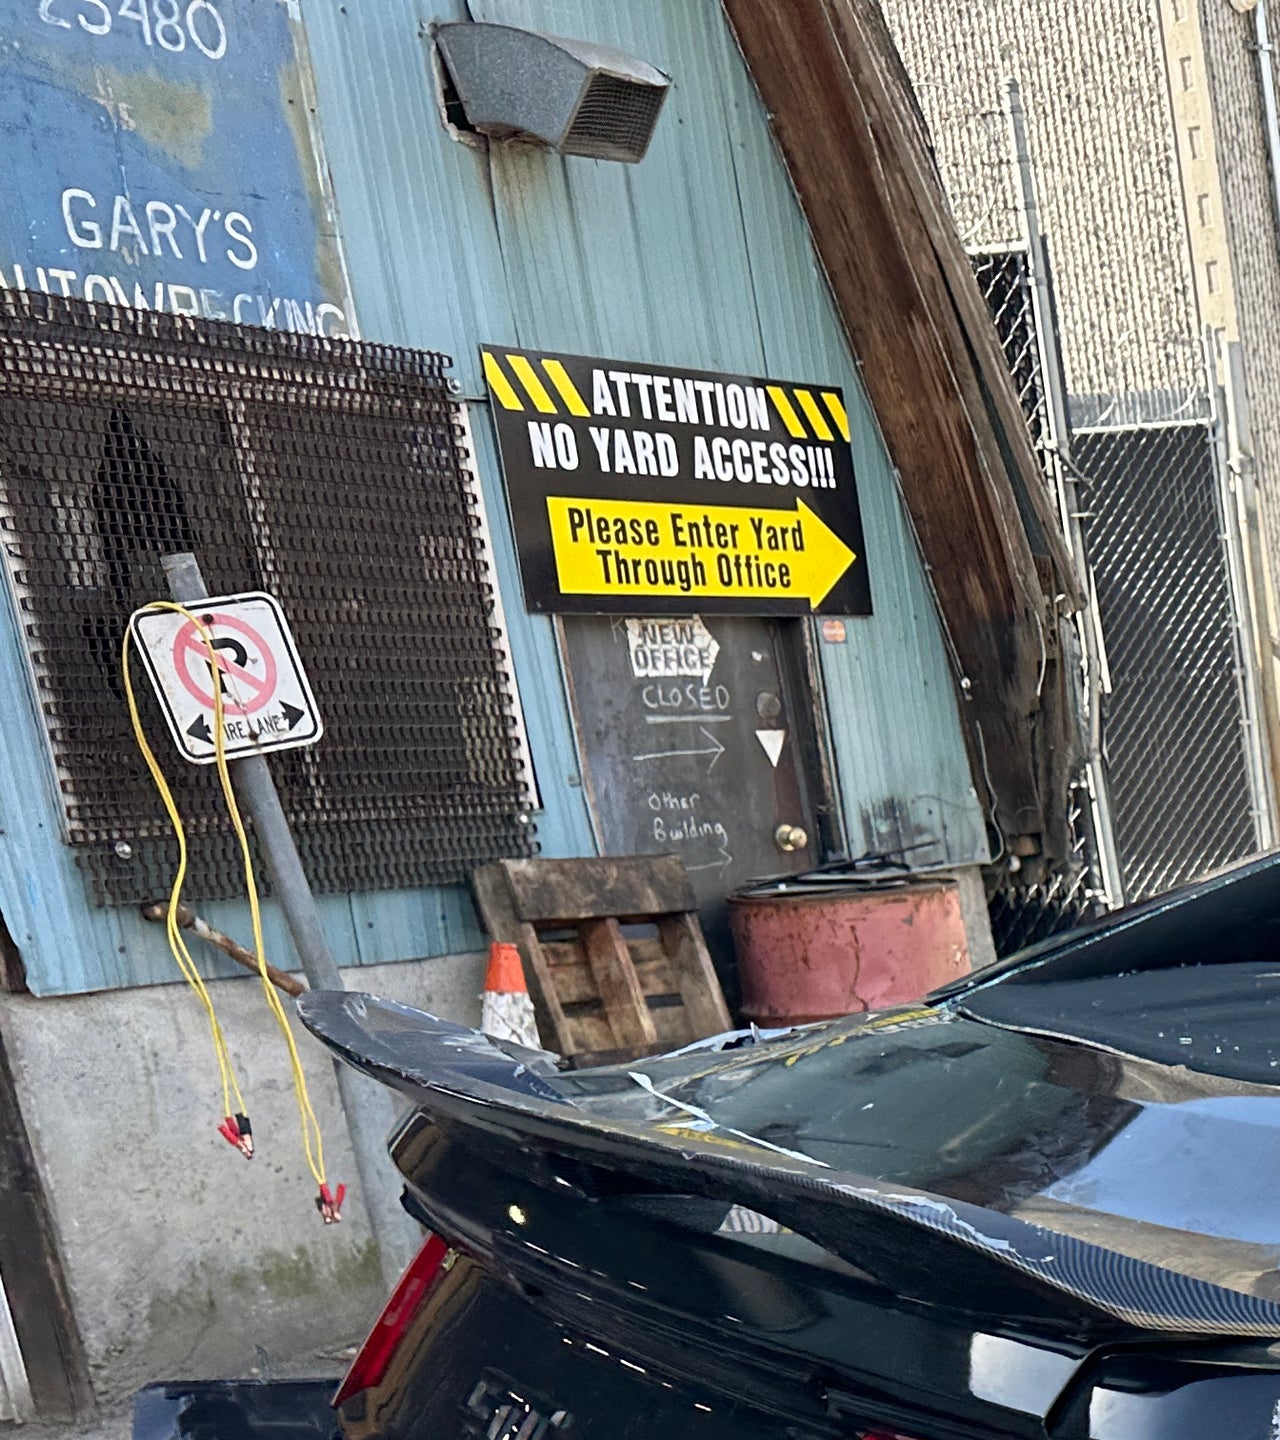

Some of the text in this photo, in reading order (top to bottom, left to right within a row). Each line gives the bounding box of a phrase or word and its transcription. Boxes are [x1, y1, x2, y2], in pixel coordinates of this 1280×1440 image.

[61, 187, 258, 270] GARY'S
[592, 369, 771, 431] ATTENTION
[527, 421, 837, 489] NO YARD ACCESS!!!
[567, 507, 805, 552] Please Enter Yard
[596, 549, 791, 592] Through Office
[642, 624, 695, 644] NEW
[634, 645, 712, 670] OFFICE
[642, 684, 730, 710] CLOSED
[222, 720, 247, 741] IRE
[649, 792, 701, 811] Other
[652, 816, 729, 848] Building
